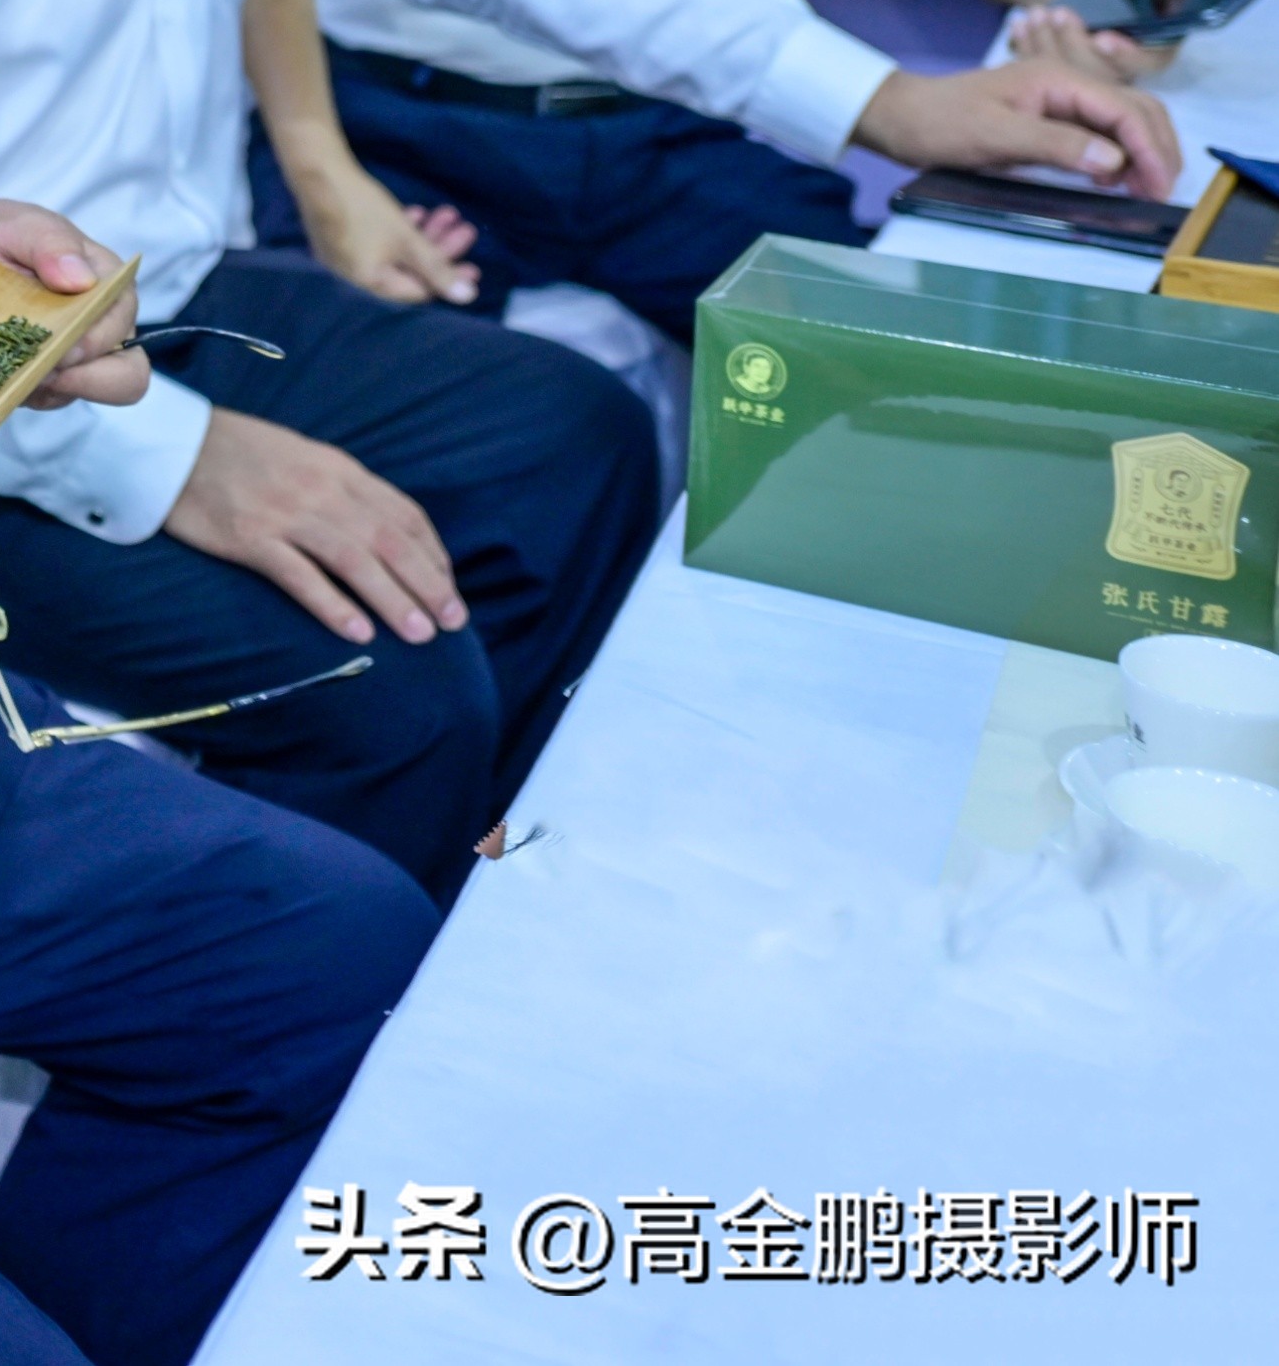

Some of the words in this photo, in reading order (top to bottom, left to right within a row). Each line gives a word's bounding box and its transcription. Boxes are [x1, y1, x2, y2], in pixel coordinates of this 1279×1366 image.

[1160, 502, 1193, 520] 七代
[1102, 582, 1230, 630] 张氏甘露
